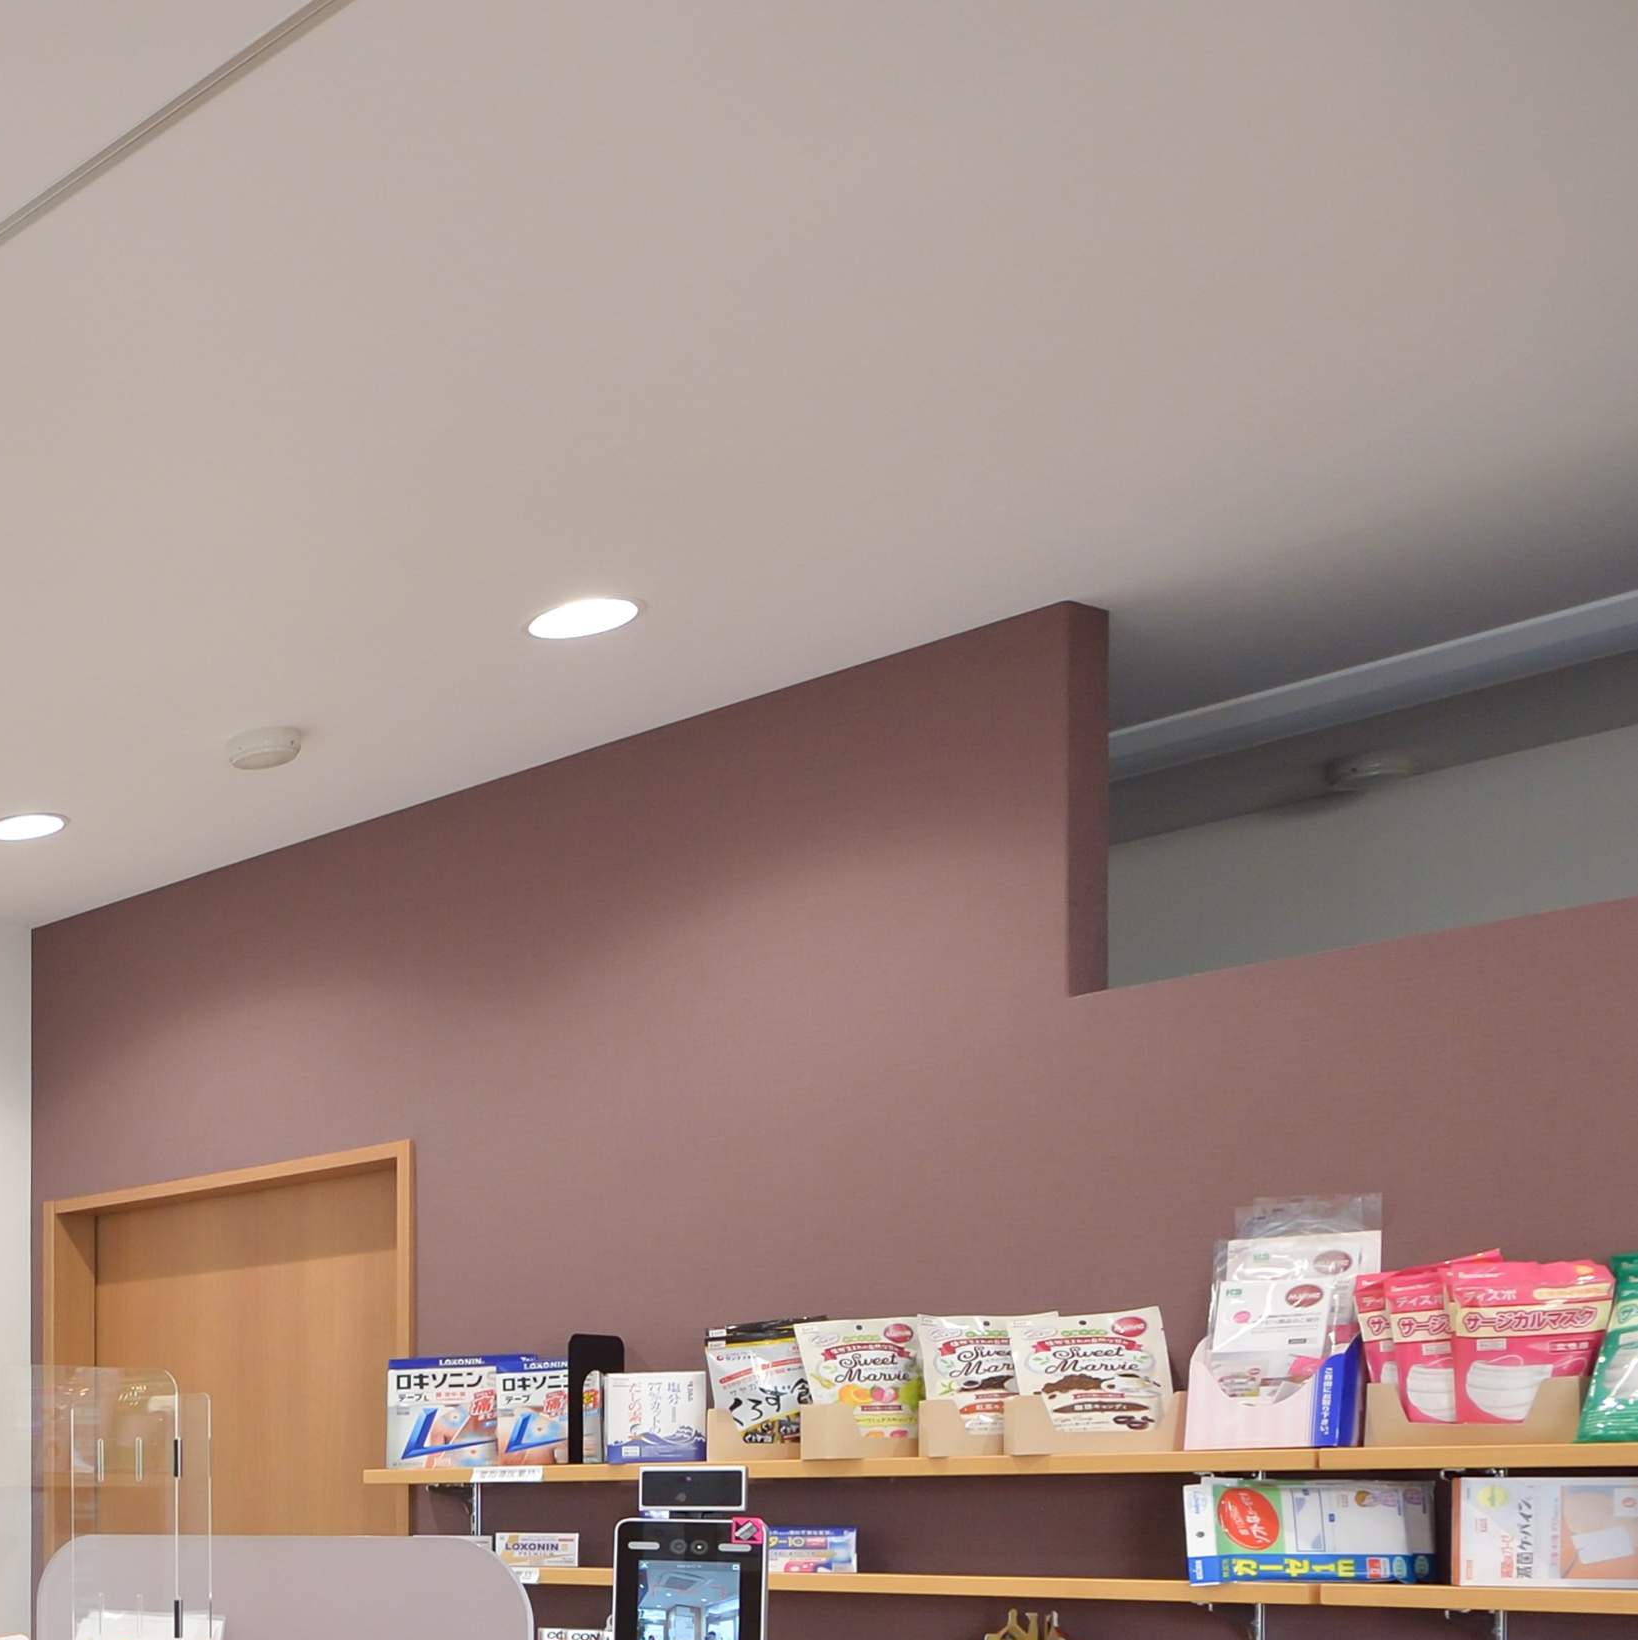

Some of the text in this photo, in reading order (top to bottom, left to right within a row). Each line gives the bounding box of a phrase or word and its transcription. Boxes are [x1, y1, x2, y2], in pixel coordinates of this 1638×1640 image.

[1463, 1306, 1598, 1332] サージカルマスク
[838, 1353, 899, 1367] Sweet
[1053, 1347, 1125, 1359] Sweet
[1045, 1362, 1141, 1374] Marvie
[396, 1372, 483, 1391] ロキソニン
[834, 1369, 912, 1383] Marvie
[502, 1375, 568, 1392] ロキソニ
[504, 1542, 559, 1552] LOXONIN
